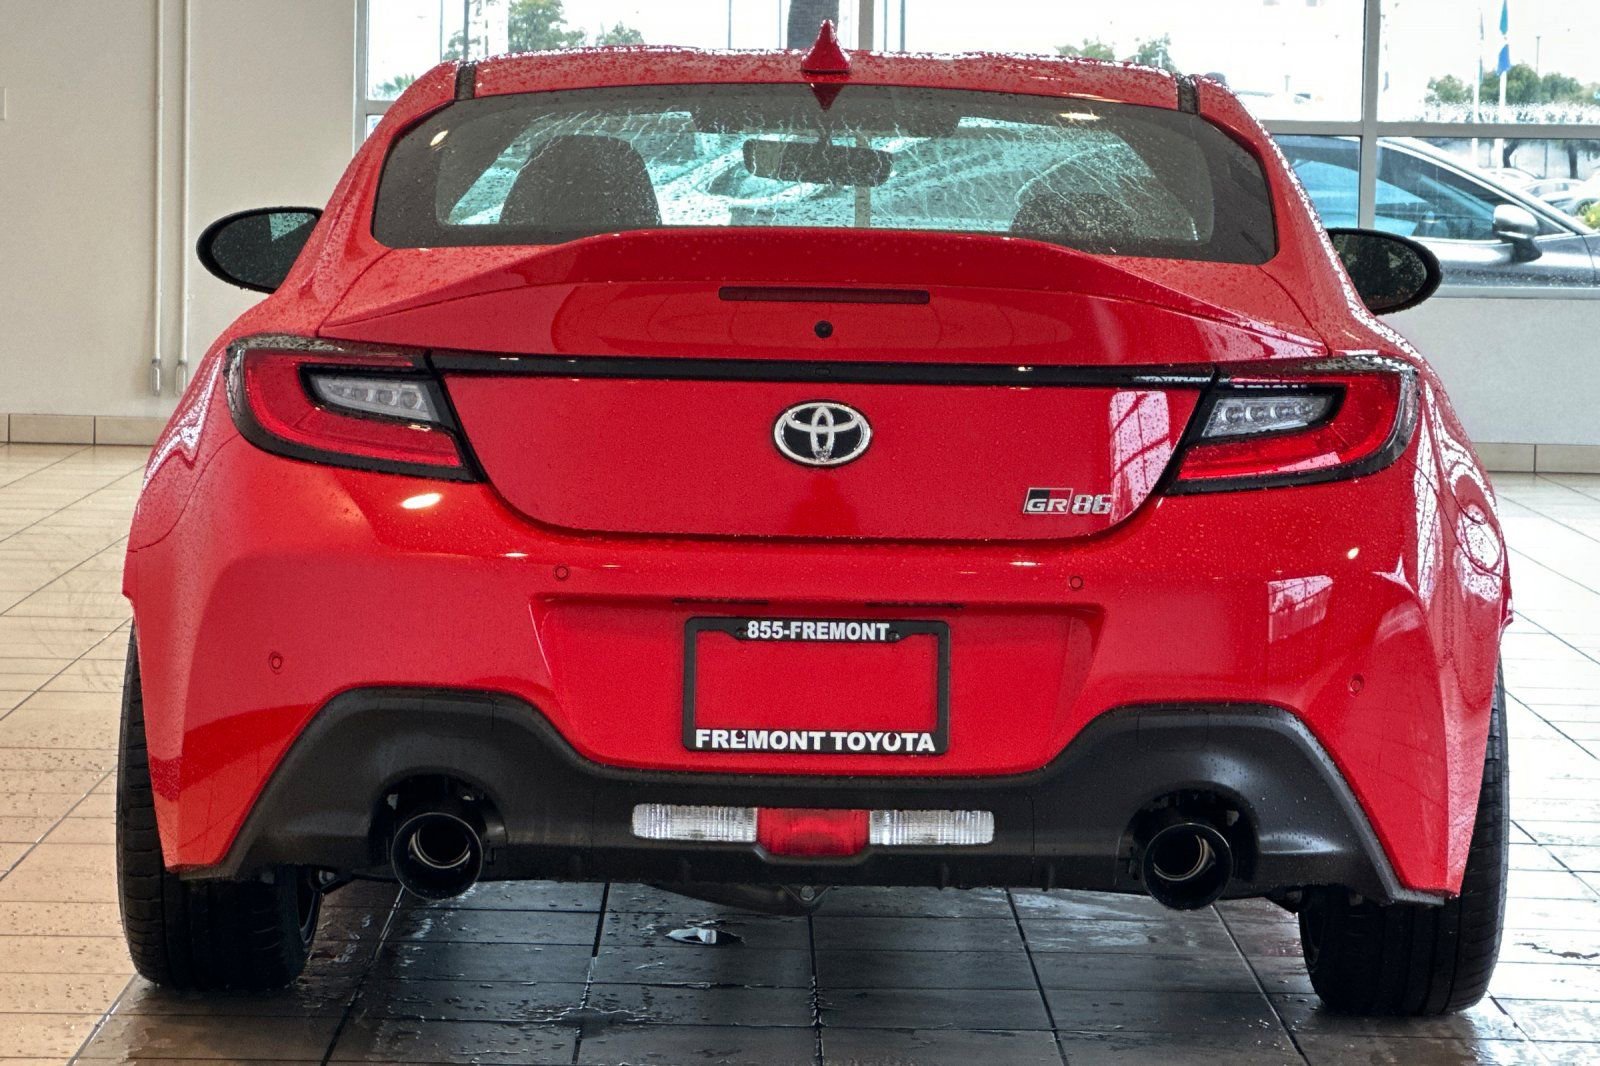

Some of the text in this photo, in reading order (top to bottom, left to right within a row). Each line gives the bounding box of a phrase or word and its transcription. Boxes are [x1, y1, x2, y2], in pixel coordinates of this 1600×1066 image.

[747, 620, 890, 641] 855-FREMONT
[695, 729, 936, 752] FREMONT TOYOTA
